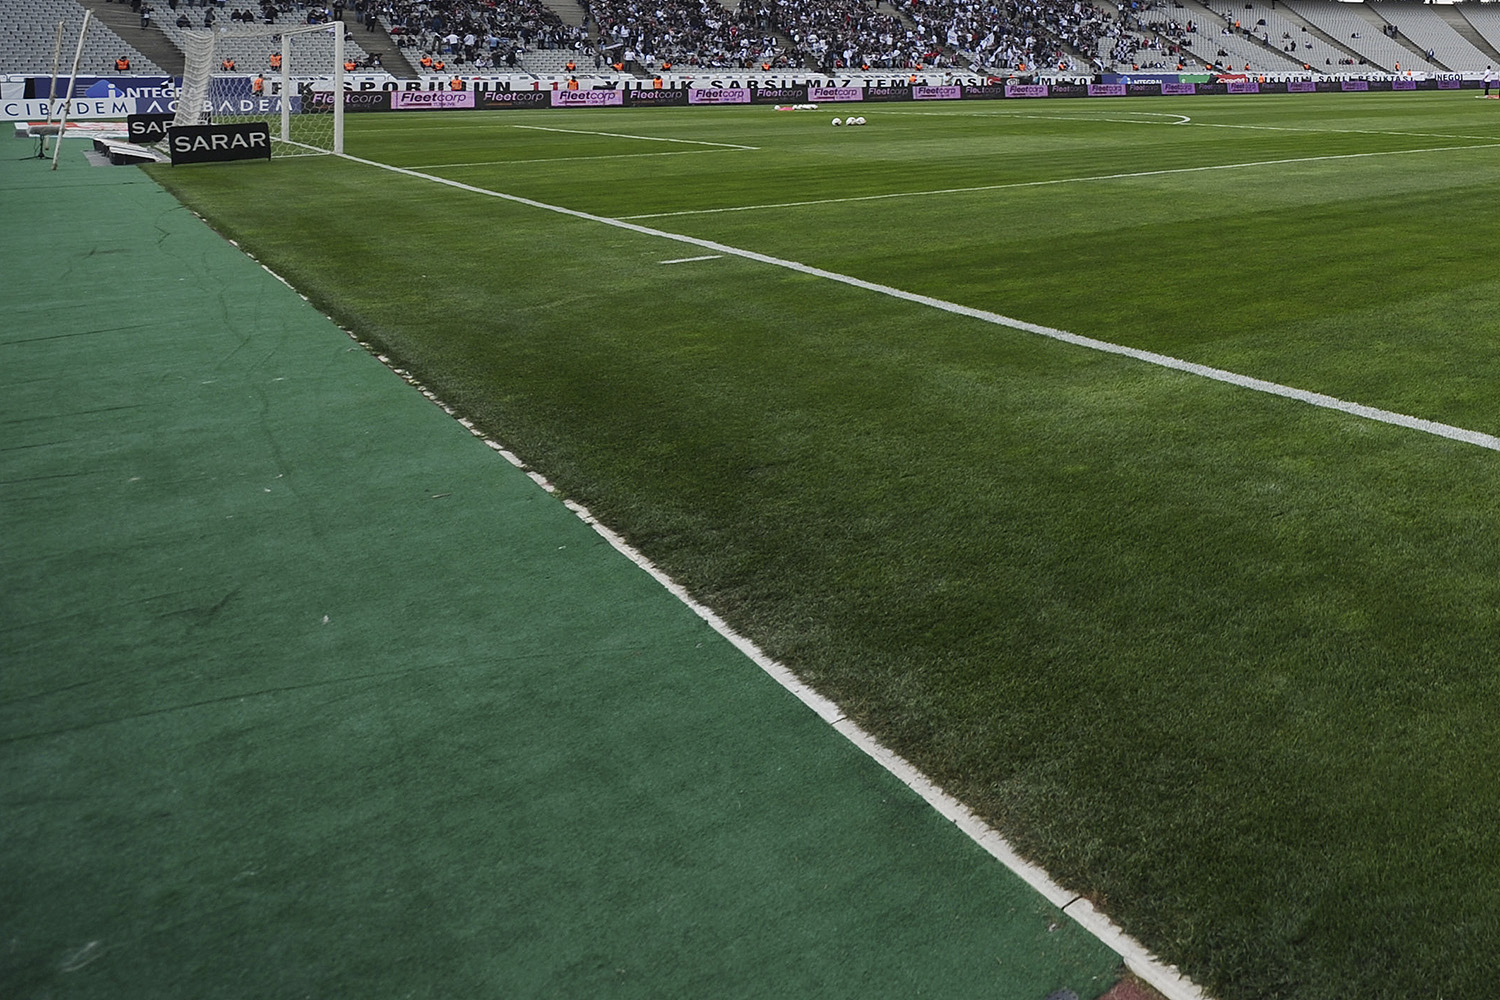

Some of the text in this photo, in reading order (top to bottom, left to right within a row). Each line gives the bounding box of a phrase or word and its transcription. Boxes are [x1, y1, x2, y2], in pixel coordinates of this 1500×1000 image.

[400, 92, 467, 103] Fleetcorp
[483, 91, 545, 102] Fleetcorp
[559, 90, 616, 101] Fleetcorp
[630, 89, 683, 100] Fleetcorp
[695, 88, 745, 99] Fleetcorp
[757, 88, 803, 98] Fleetcorp
[814, 87, 858, 97] Fleetcorp
[918, 86, 956, 95] Fleetcorp
[174, 131, 267, 153] SARAR
